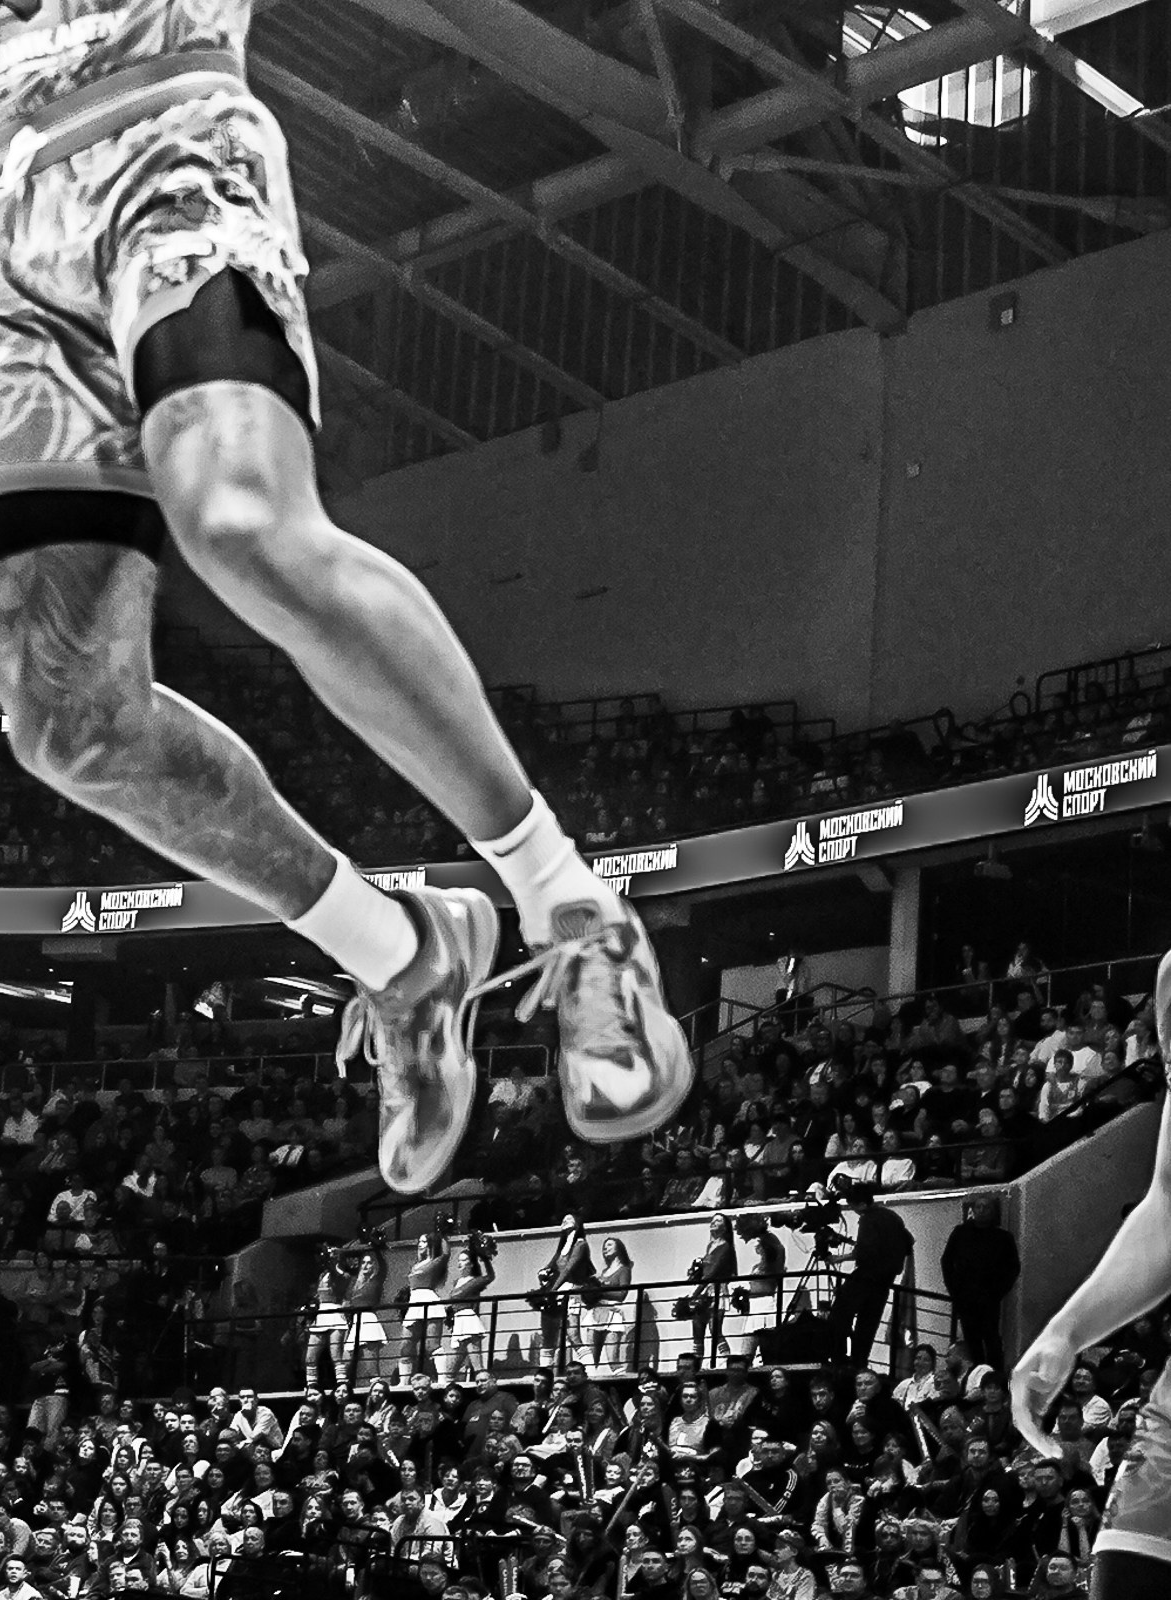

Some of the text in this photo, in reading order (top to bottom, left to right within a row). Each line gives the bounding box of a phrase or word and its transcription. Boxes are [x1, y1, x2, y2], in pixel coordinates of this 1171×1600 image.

[1064, 750, 1157, 794] МОСКОВСКИЙ
[1063, 788, 1106, 817] СПОРТ
[819, 801, 903, 840] МОСКОВСКИЙ
[819, 837, 857, 863] СПОРТ
[100, 884, 183, 910] МОСКОВСКИЙ
[98, 909, 138, 931] СПОРТ
